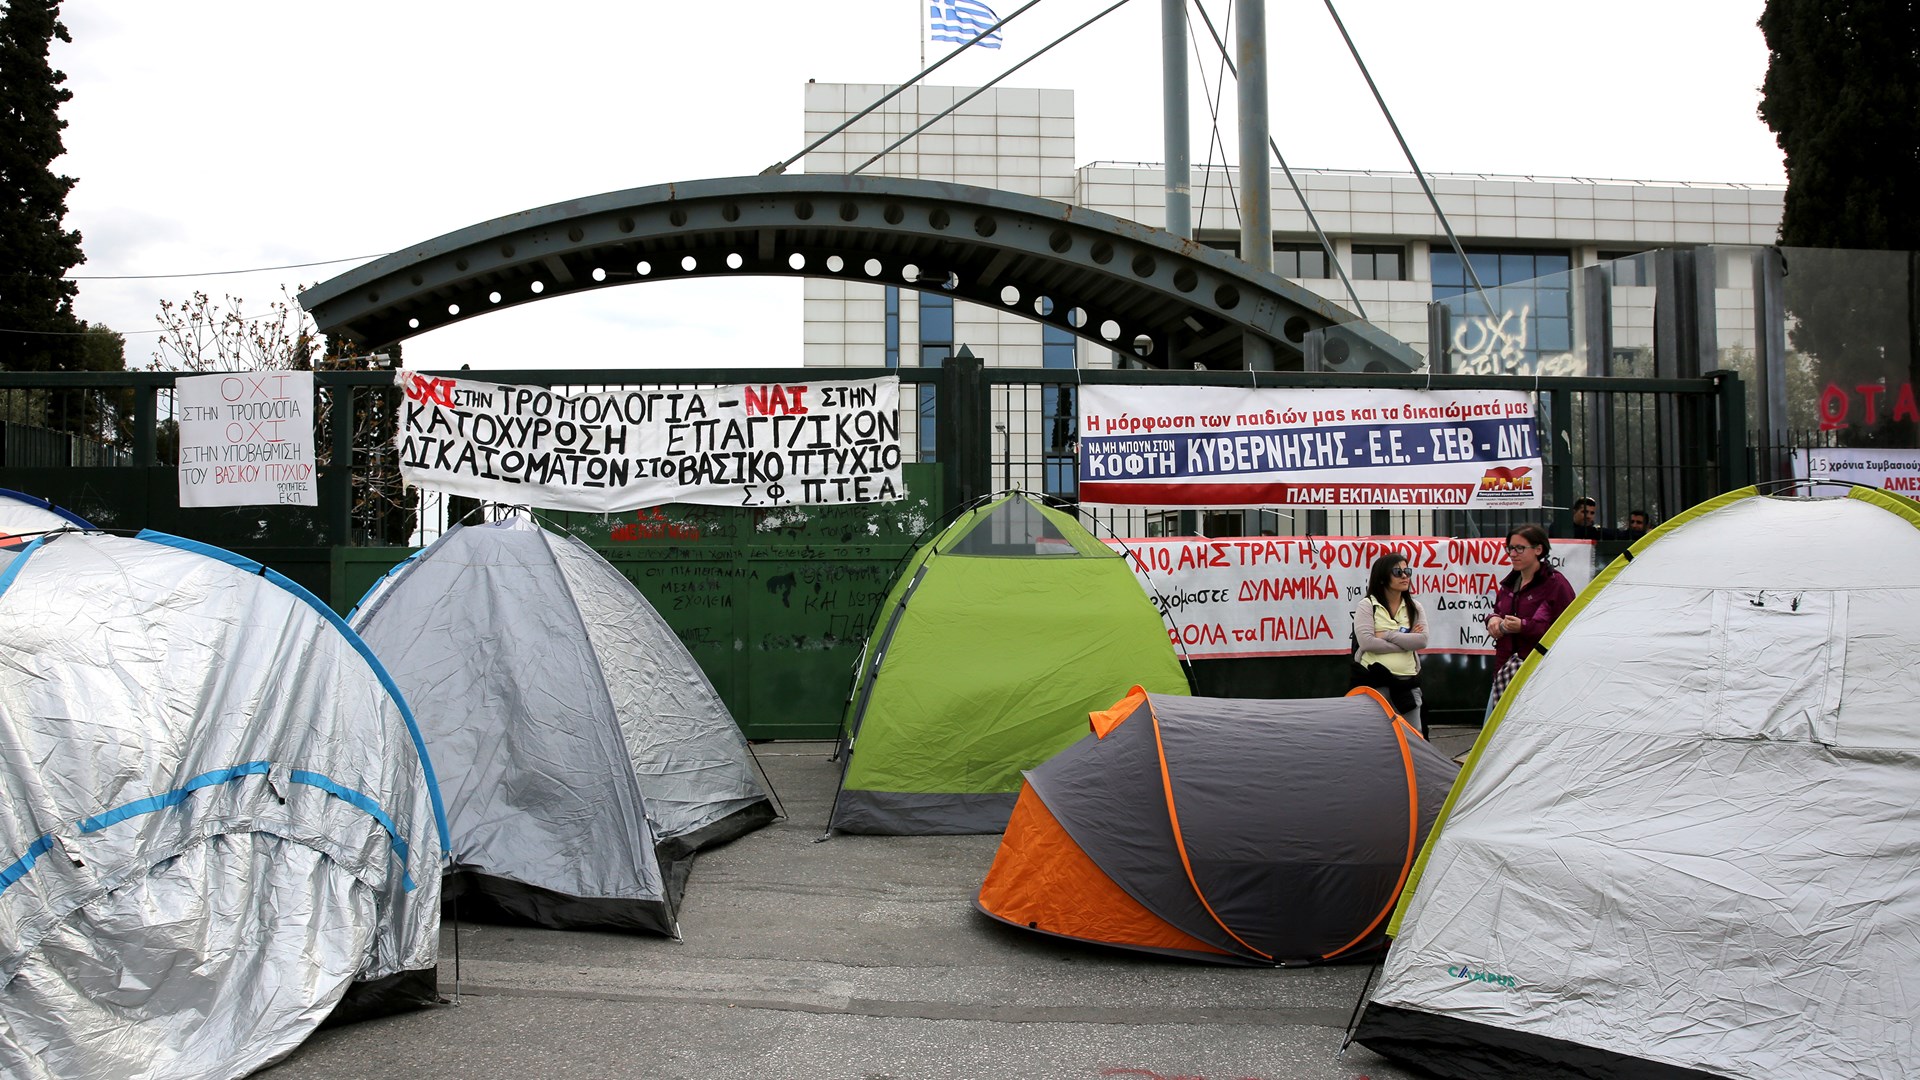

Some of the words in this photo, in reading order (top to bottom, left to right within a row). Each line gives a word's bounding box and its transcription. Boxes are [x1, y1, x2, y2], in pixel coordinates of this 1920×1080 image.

[221, 375, 291, 401] ΟΧΙ
[403, 371, 456, 409] ΟΧΙ
[454, 389, 492, 408] ΣΤΗΝ
[498, 385, 707, 424] ΤΡΟΠΟΛΟΓΙΑ
[744, 384, 808, 416] ΝΑΙ
[821, 383, 876, 409] ΣΤΗΝ
[183, 406, 218, 421] ΣΤΗΝ
[227, 400, 301, 420] ΤΡΟΠΟΛΟΓΙΑ
[1087, 415, 1100, 431] Η
[1106, 413, 1195, 434] μόρφωση
[1200, 415, 1231, 428] των
[1236, 407, 1307, 426] παιδιών
[1313, 408, 1346, 426] μας
[1351, 407, 1377, 421] και
[1381, 407, 1398, 420] τα
[1403, 399, 1501, 421] δικαιώματά
[1505, 402, 1528, 419] μας
[226, 420, 285, 443] ΟΧΙ
[406, 401, 627, 454] ΚΑΤΟΧΥΡΩΣΗ
[666, 409, 900, 456] ΕΠΑΓΓ/ΙΚΩΝ
[182, 446, 218, 463] ΣΤΗΝ
[222, 443, 301, 462] ΥΠΟΒΑΘΜΙΣΗ
[1088, 442, 1101, 454] ΝΑ
[1102, 442, 1116, 453] ΜΗ
[1119, 440, 1151, 453] ΜΠΟΥΝ
[1153, 440, 1175, 452] ΣΤΟΝ
[1187, 431, 1349, 473] ΚΥΒΕΡΝΗΣΗΣ
[1369, 430, 1411, 464] Ε.Ε.
[1430, 428, 1474, 461] ΣΕΒ
[1497, 424, 1532, 458] ΔΝΤ
[400, 435, 630, 488] ΔΙΚΑΙΩΜΑΤΩΝ
[635, 457, 676, 478] ΣΤΟ
[678, 450, 784, 486] ΒΑΣΙΚΟ
[788, 444, 901, 476] ΠΤΥΧΙΟ
[1089, 453, 1176, 476] ΚΟΦΤΗ
[1810, 458, 1827, 471] 15
[1829, 460, 1864, 471] χρόνια
[181, 468, 208, 484] ΤΟΥ
[215, 465, 260, 484] ΒΑΣΙΚΟΥ
[265, 464, 312, 481] ΠΤΥΧΙΟΥ
[1287, 487, 1334, 504] ΠΑΜΕ
[1340, 487, 1467, 504] ΕΚΠΑΙΔΕΥΤΙΚΩΝ
[1238, 575, 1339, 602] ΔΥΝΑΜΙΚΑ
[1346, 586, 1361, 601] για
[1183, 623, 1227, 645] ΟΛΑ
[1232, 629, 1257, 642] τα
[1260, 614, 1333, 641] ΠΑΙΔΙΑ
[1448, 965, 1516, 988] CAMPUS
